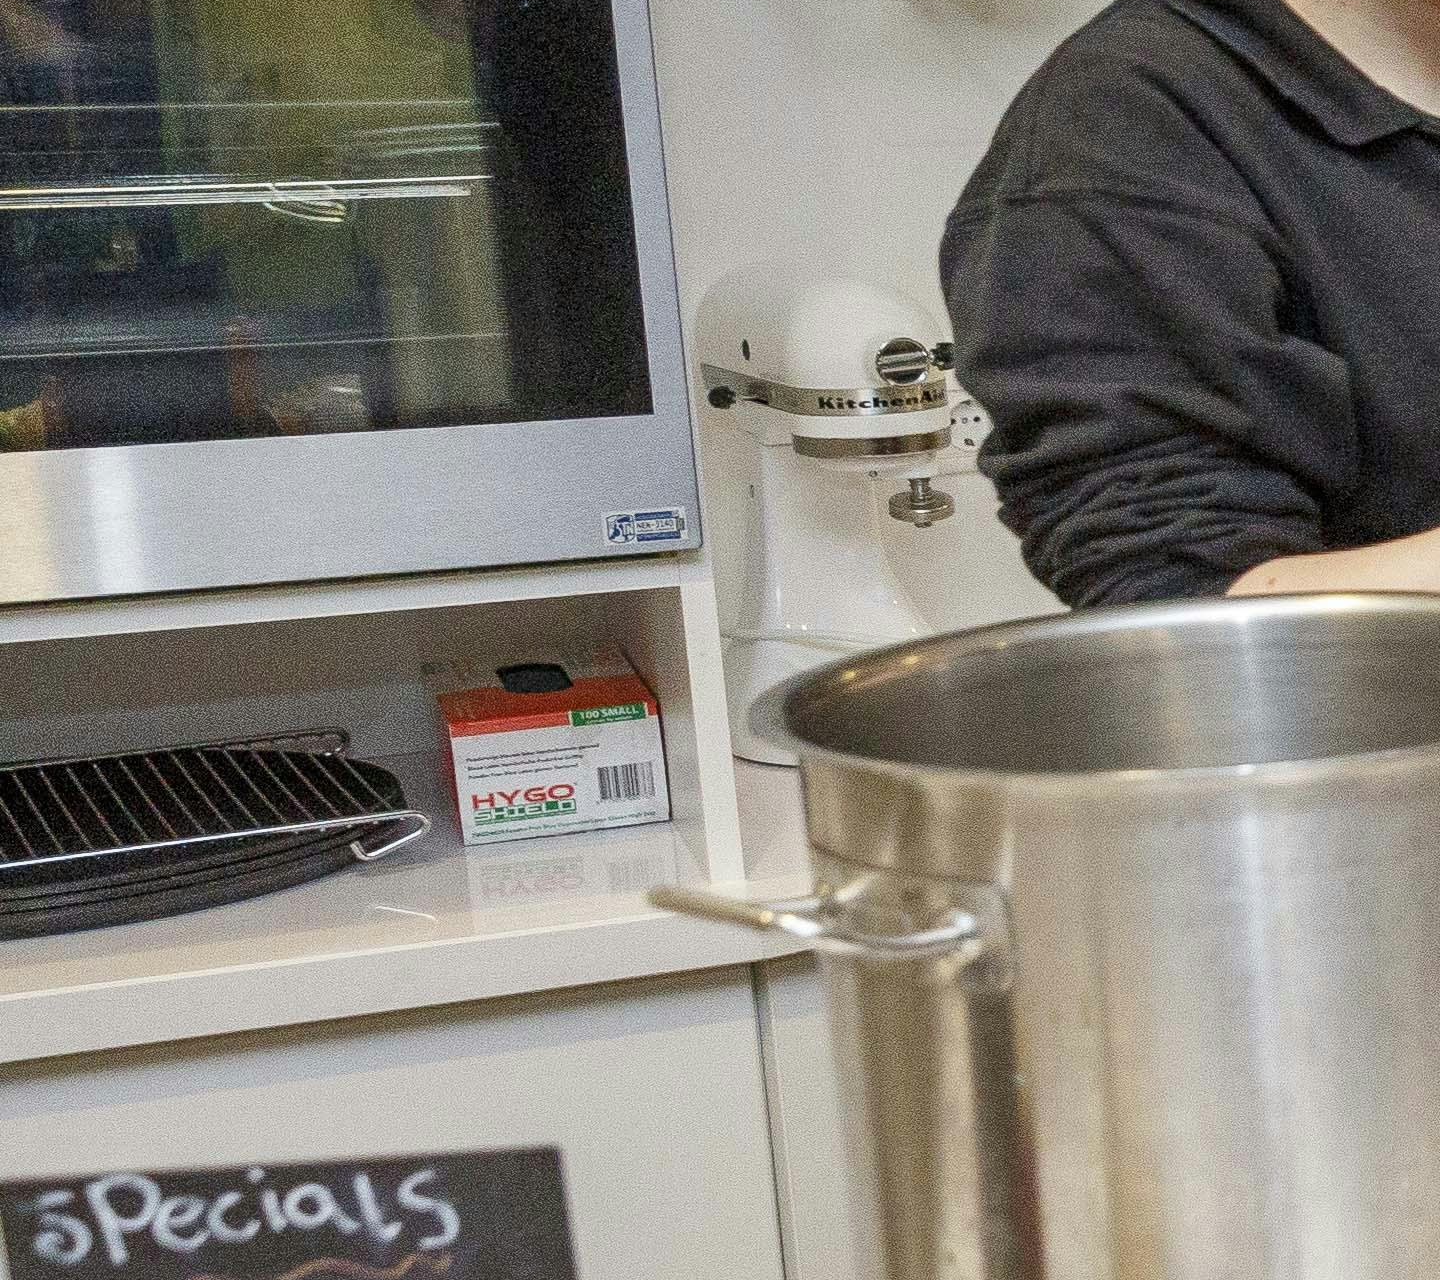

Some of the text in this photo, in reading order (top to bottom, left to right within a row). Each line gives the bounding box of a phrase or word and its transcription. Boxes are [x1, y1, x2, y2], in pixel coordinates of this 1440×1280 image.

[579, 705, 640, 719] 100 SMALL
[472, 783, 576, 810] HYGO
[473, 799, 577, 823] SHIELD
